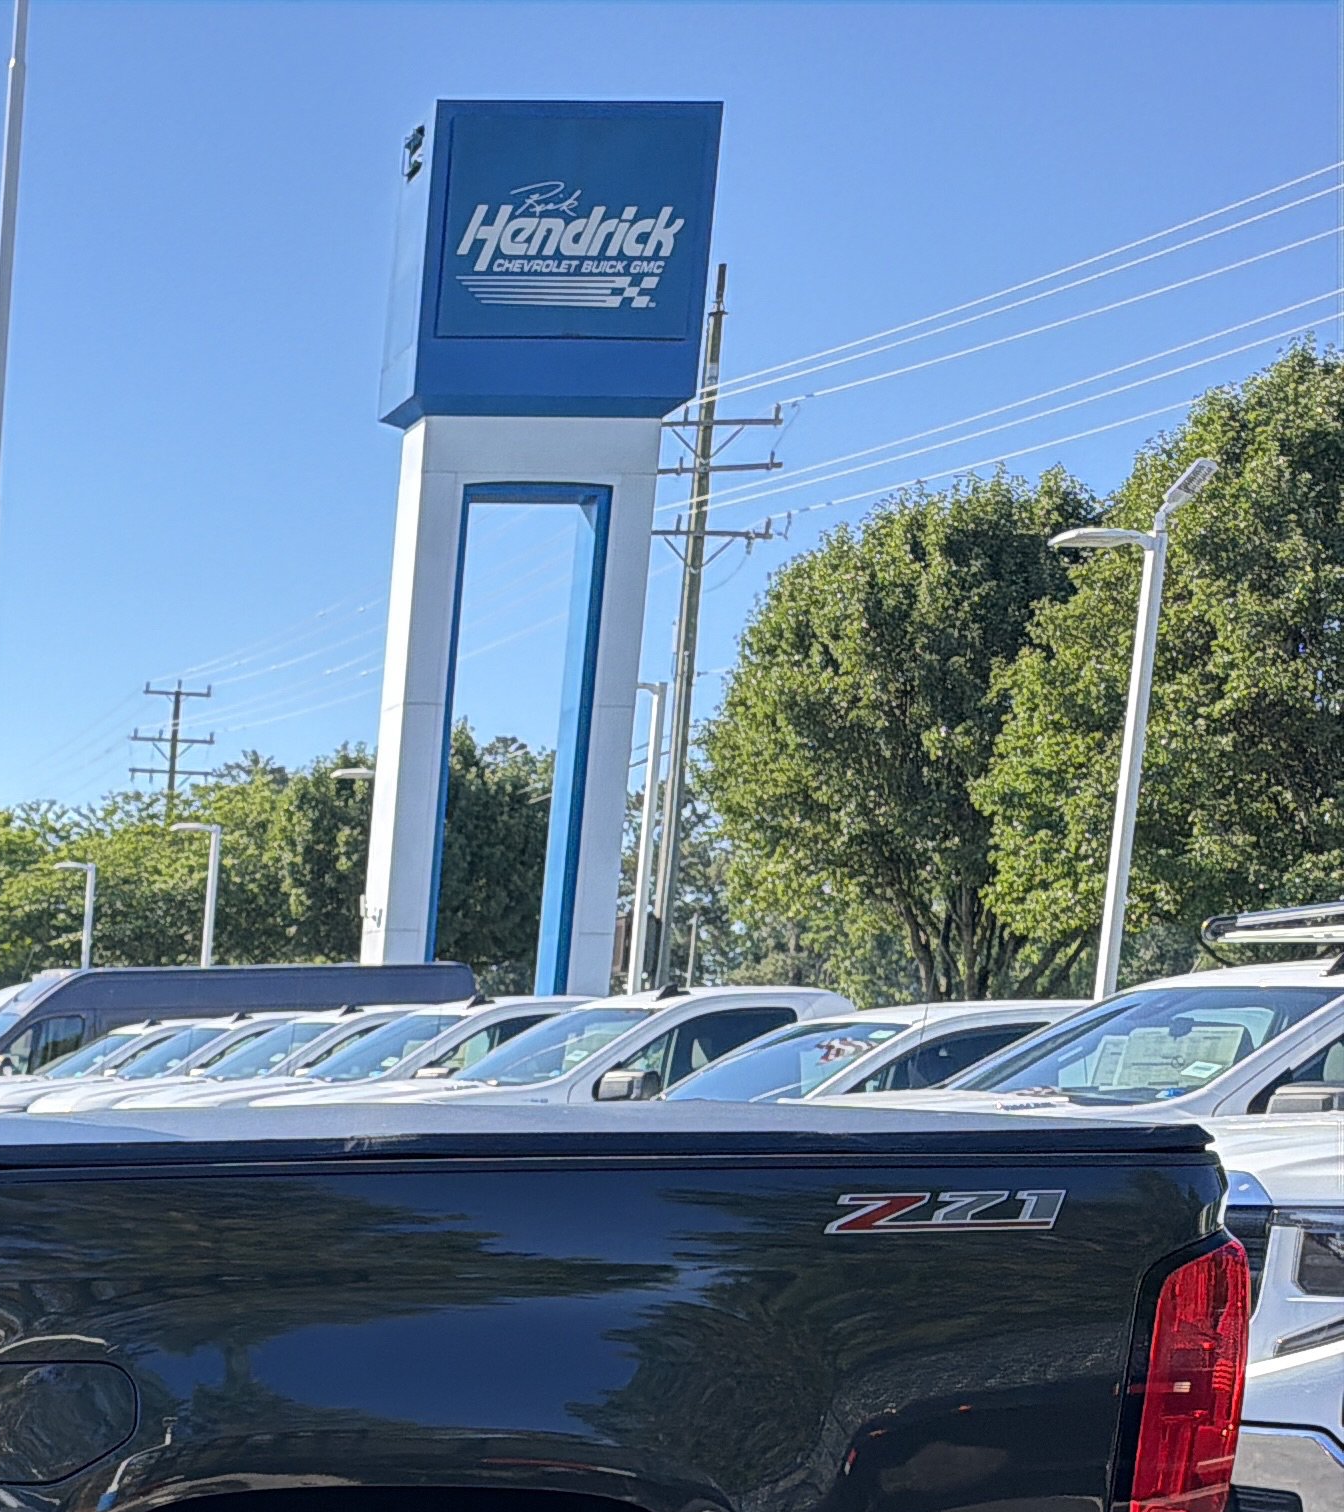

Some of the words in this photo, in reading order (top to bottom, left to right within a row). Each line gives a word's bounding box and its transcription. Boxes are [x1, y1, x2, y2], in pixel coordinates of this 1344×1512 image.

[456, 204, 685, 272] Hendrick
[492, 258, 580, 273] CHEVROLET
[580, 260, 627, 273] BUICK
[629, 260, 665, 274] GMC
[824, 1189, 1066, 1235] Z71
